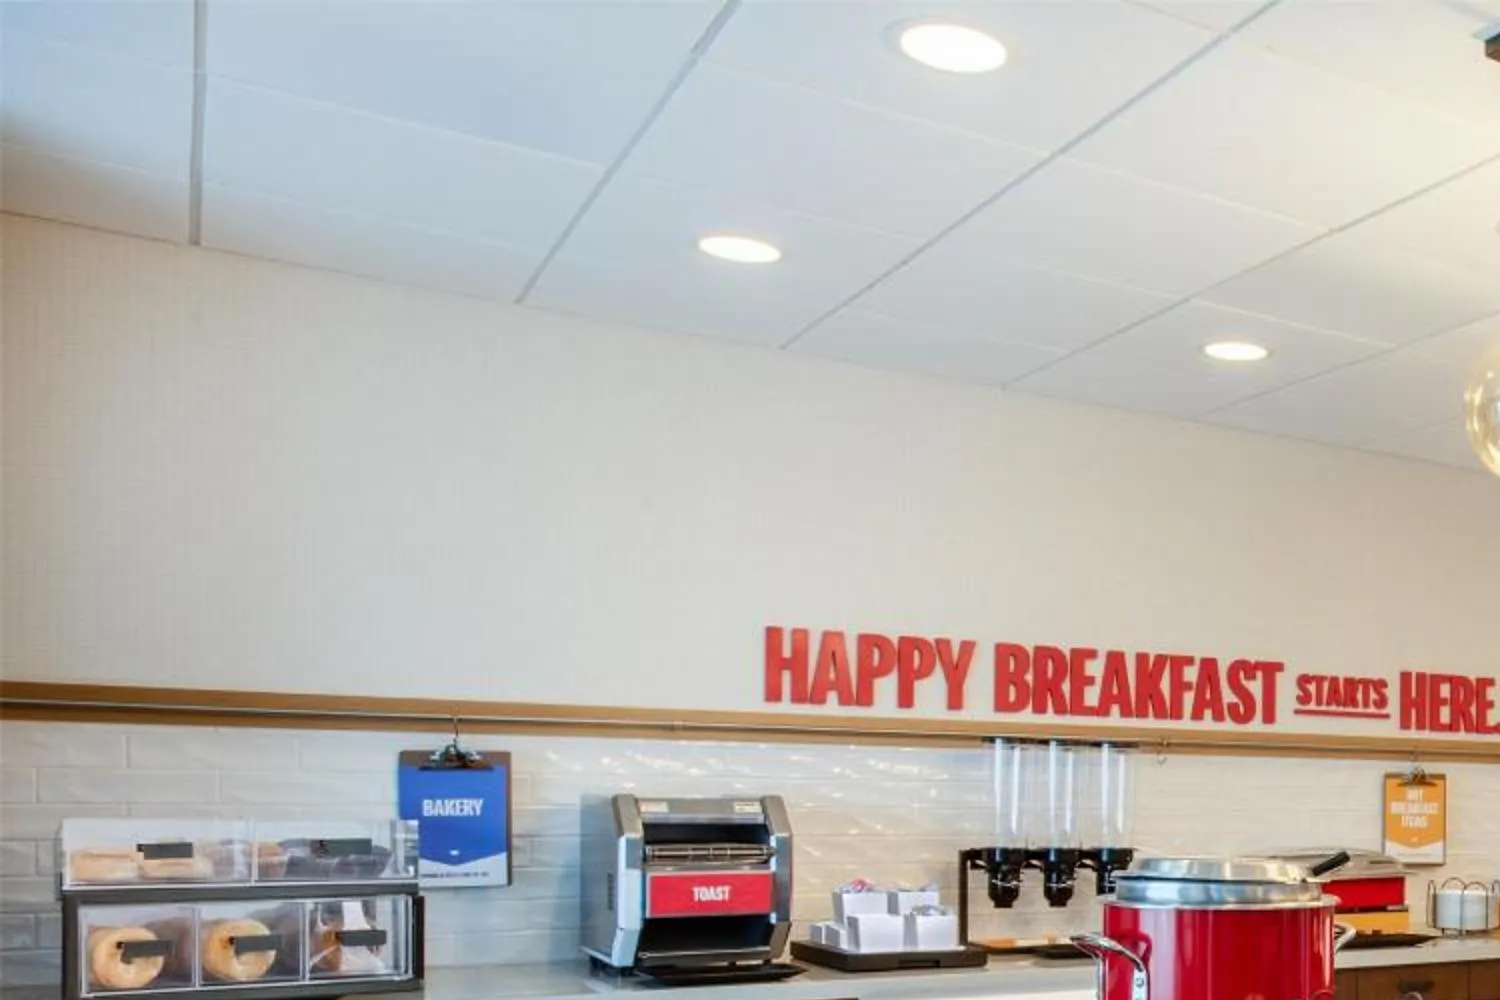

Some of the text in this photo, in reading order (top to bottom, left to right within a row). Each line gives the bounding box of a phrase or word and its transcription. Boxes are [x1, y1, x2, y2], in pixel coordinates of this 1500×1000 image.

[764, 625, 976, 711] HAPPY
[993, 642, 1284, 725] BREAKFAST
[1295, 673, 1389, 709] STARTS
[422, 798, 484, 817] BAKERY
[692, 885, 731, 902] TOAST
